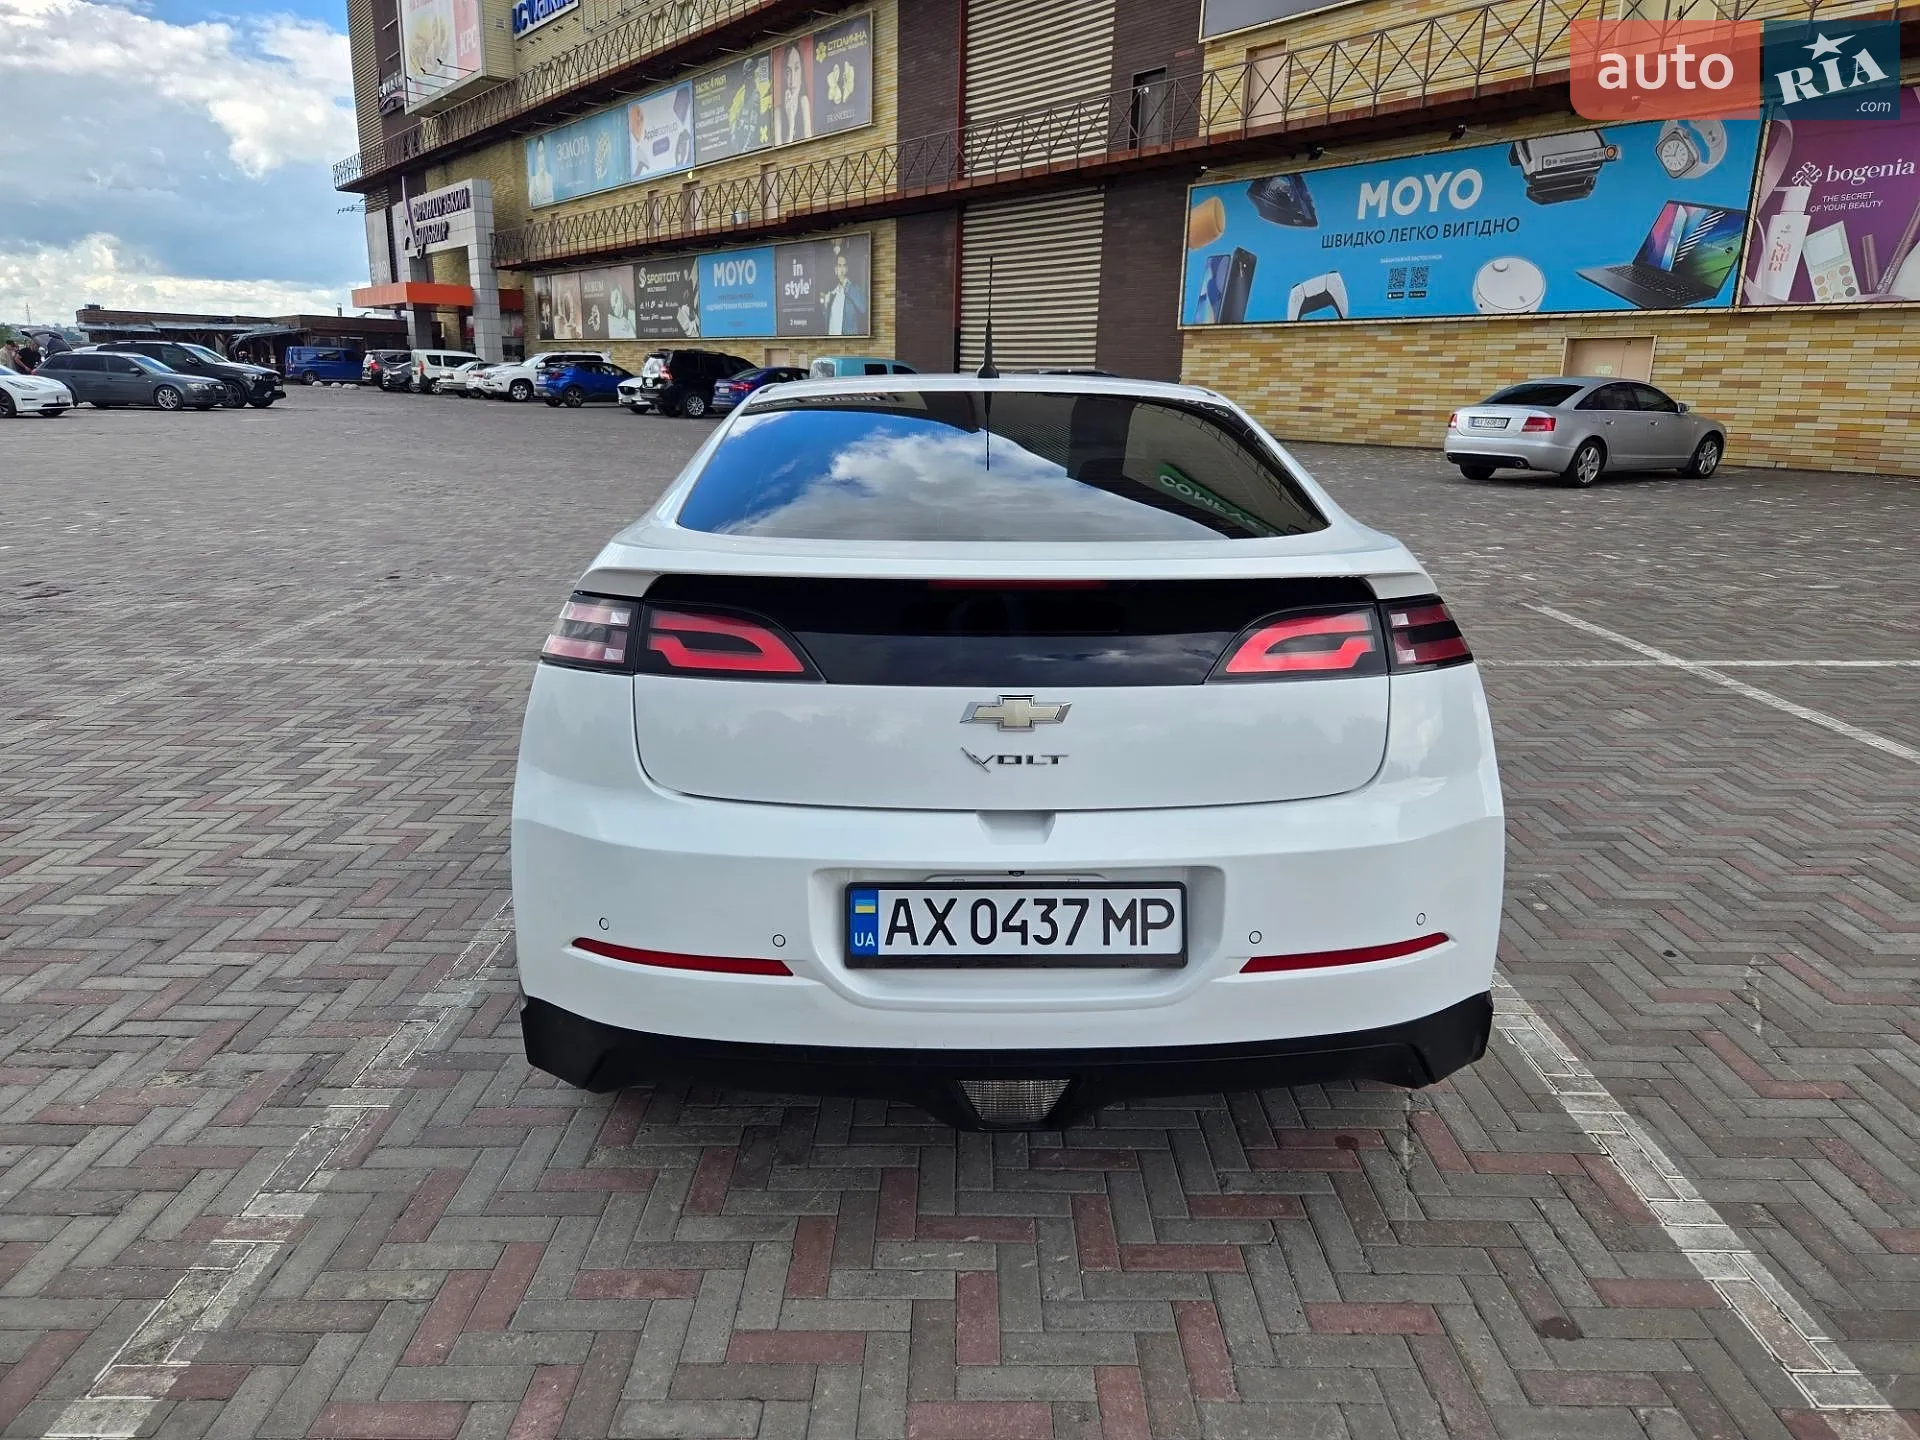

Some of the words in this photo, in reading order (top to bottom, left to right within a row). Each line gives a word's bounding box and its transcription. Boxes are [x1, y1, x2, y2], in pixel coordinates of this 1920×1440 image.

[1826, 158, 1915, 186] bogenia
[1356, 168, 1483, 220] MOYO
[1810, 205, 1821, 213] OF
[1823, 203, 1846, 212] YOUR
[1848, 200, 1884, 210] BEAUTY
[1822, 194, 1839, 202] THE
[1840, 191, 1874, 201] SECRET
[1321, 229, 1385, 249] ШВИДКО
[1388, 224, 1439, 243] ЛЕГКО
[1443, 217, 1520, 239] ВИГІДНО
[713, 258, 757, 288] MOYO
[792, 259, 803, 277] in
[960, 744, 1069, 773] VOLT
[885, 897, 958, 946] AX
[969, 897, 1090, 946] 0437
[1102, 897, 1176, 946] MP
[854, 932, 876, 948] UA
